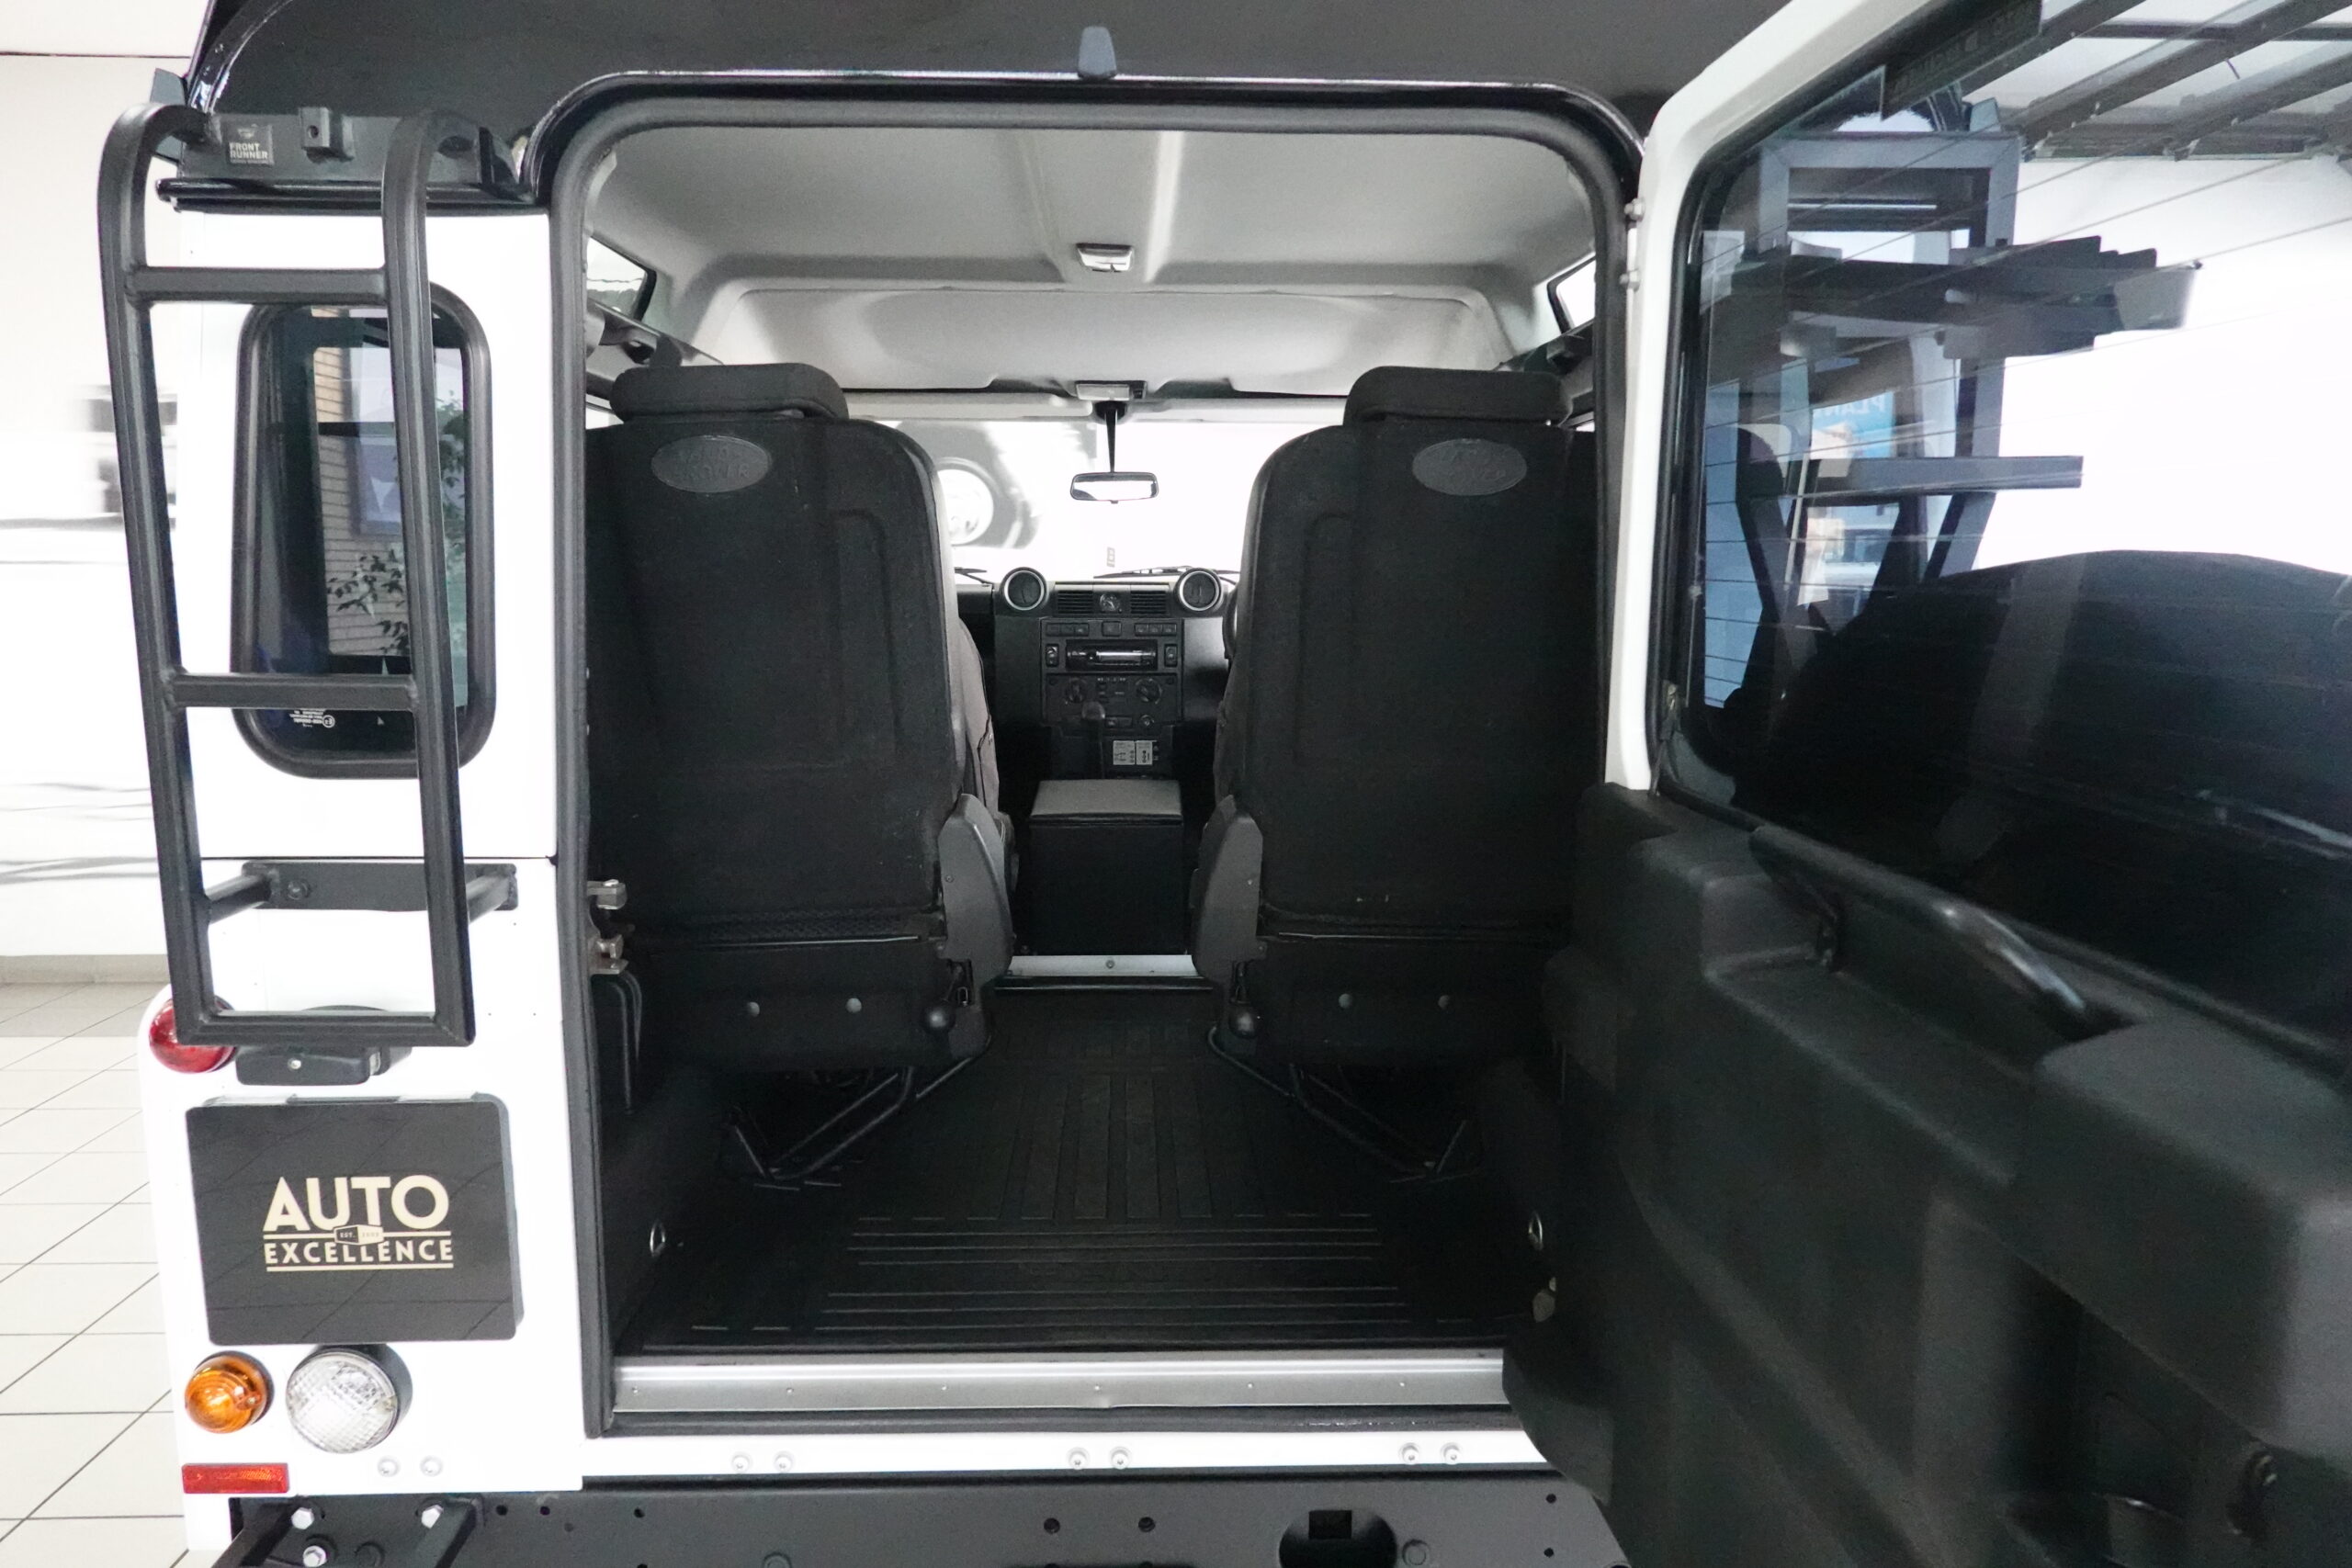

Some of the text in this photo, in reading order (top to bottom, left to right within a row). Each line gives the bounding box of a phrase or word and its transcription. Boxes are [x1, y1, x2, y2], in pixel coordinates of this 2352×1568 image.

[230, 141, 260, 152] FRONT
[230, 150, 268, 160] RUNNER
[263, 1175, 449, 1232] AUTO
[264, 1240, 454, 1264] EXCELLENCE
